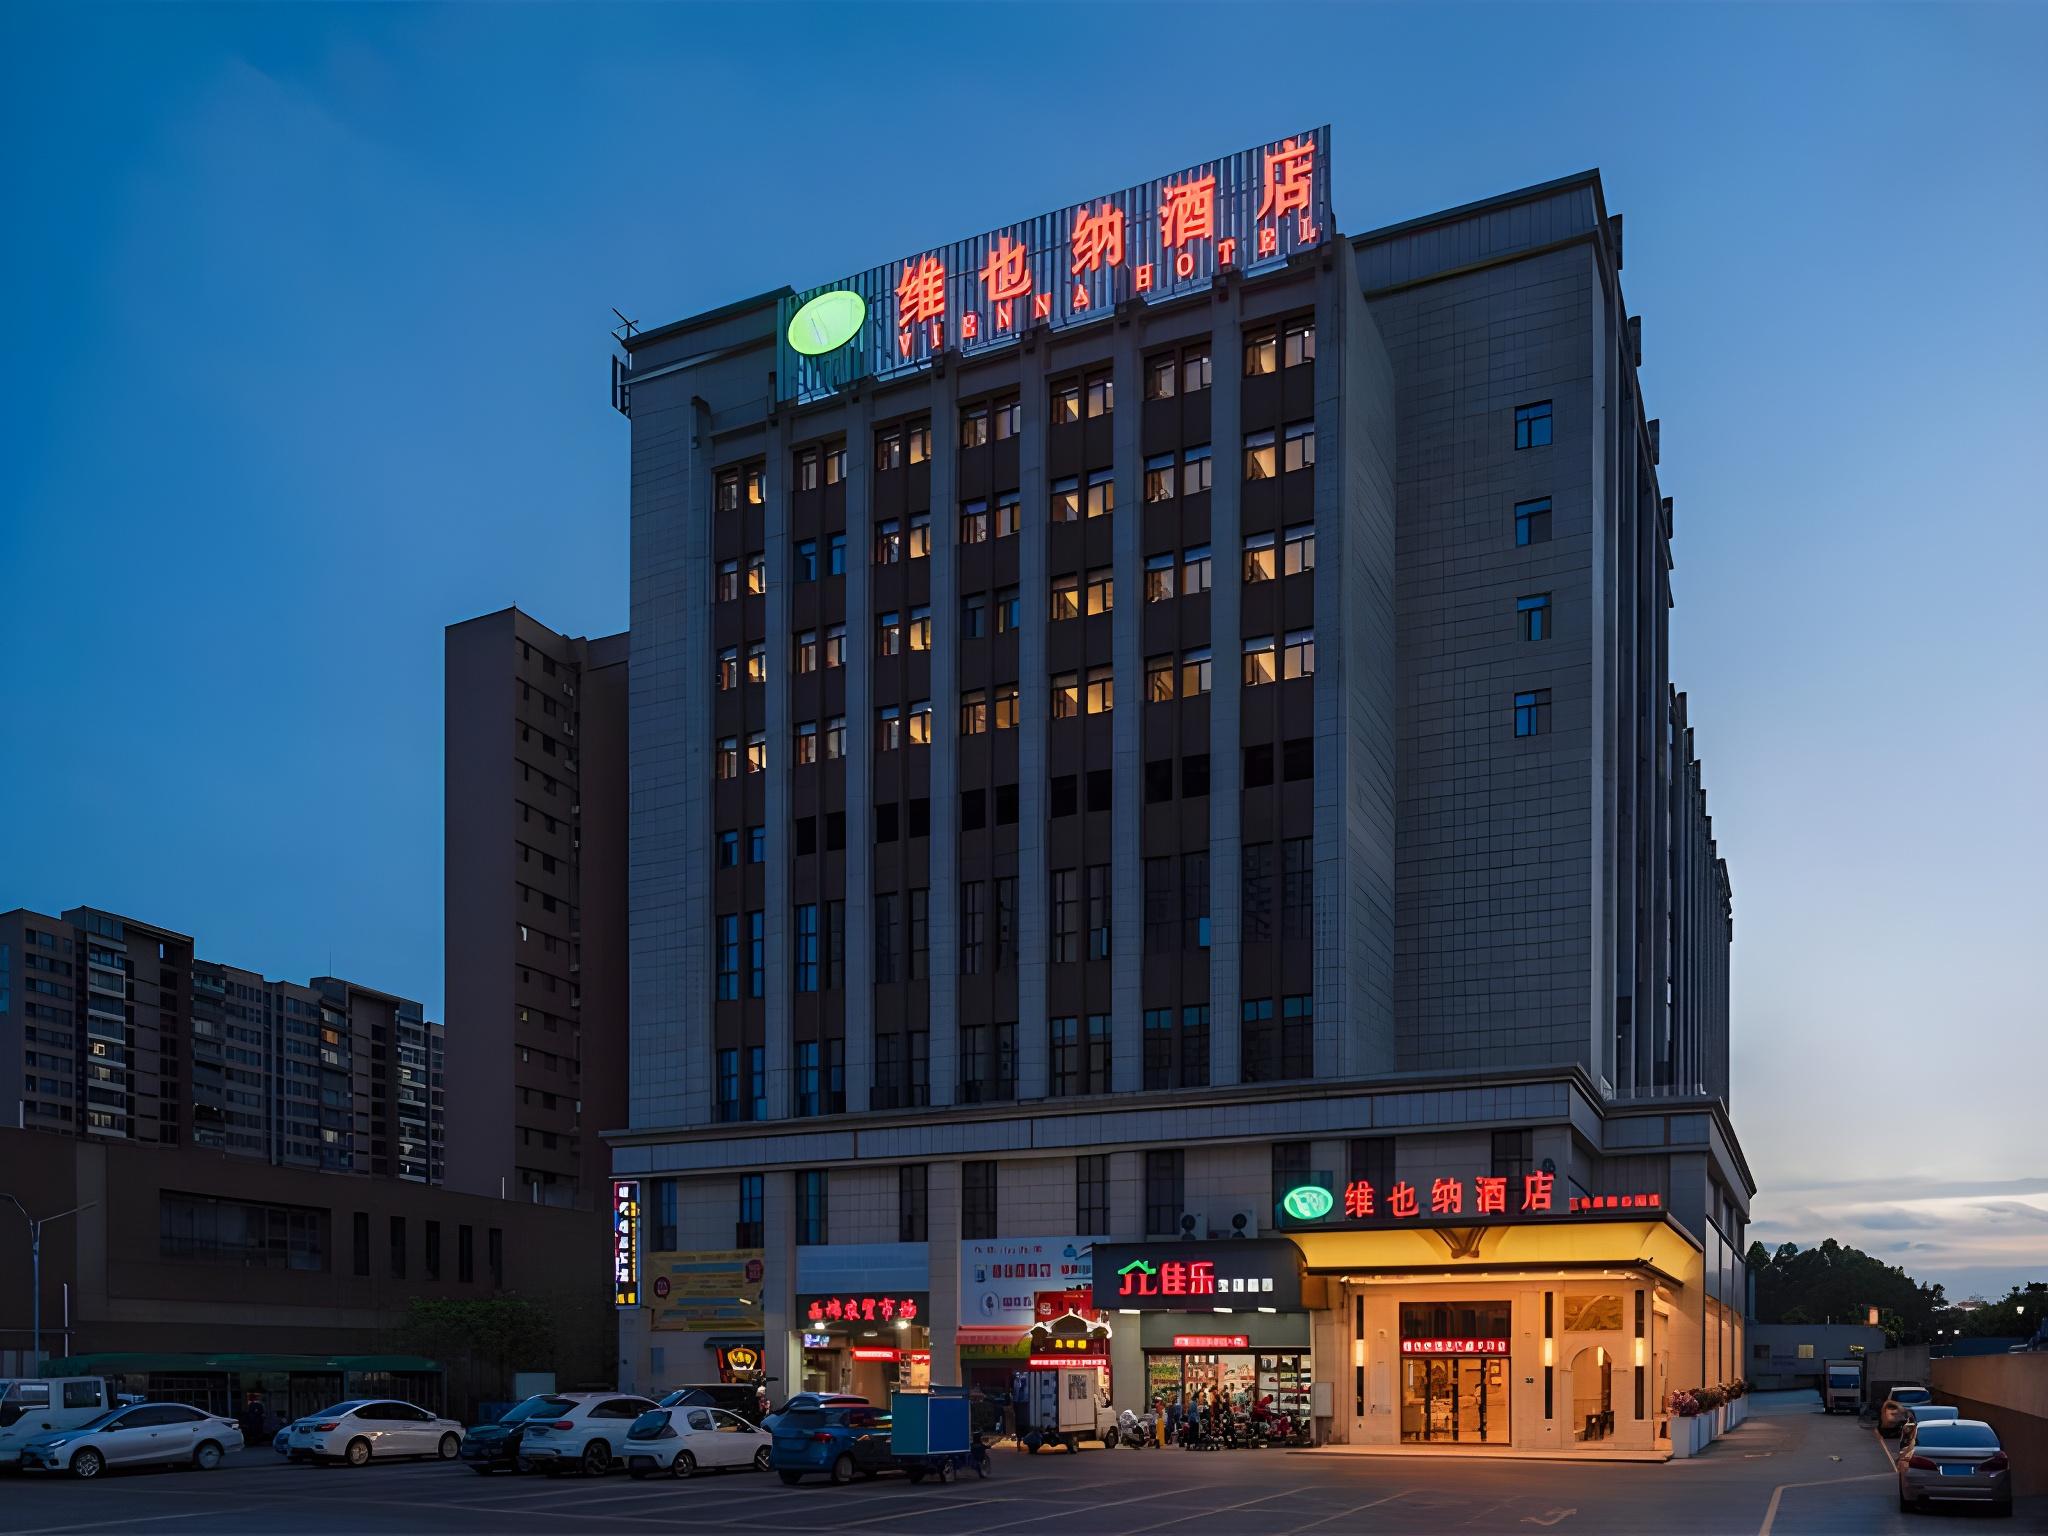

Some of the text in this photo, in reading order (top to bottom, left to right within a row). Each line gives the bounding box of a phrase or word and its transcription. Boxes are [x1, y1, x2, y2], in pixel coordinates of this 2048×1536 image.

[895, 138, 1316, 329] 维也纳酒店
[898, 216, 1317, 357] VIENNA HOTEL
[1345, 1170, 1554, 1218] 维也纳酒店
[1161, 1261, 1215, 1295] 佳乐
